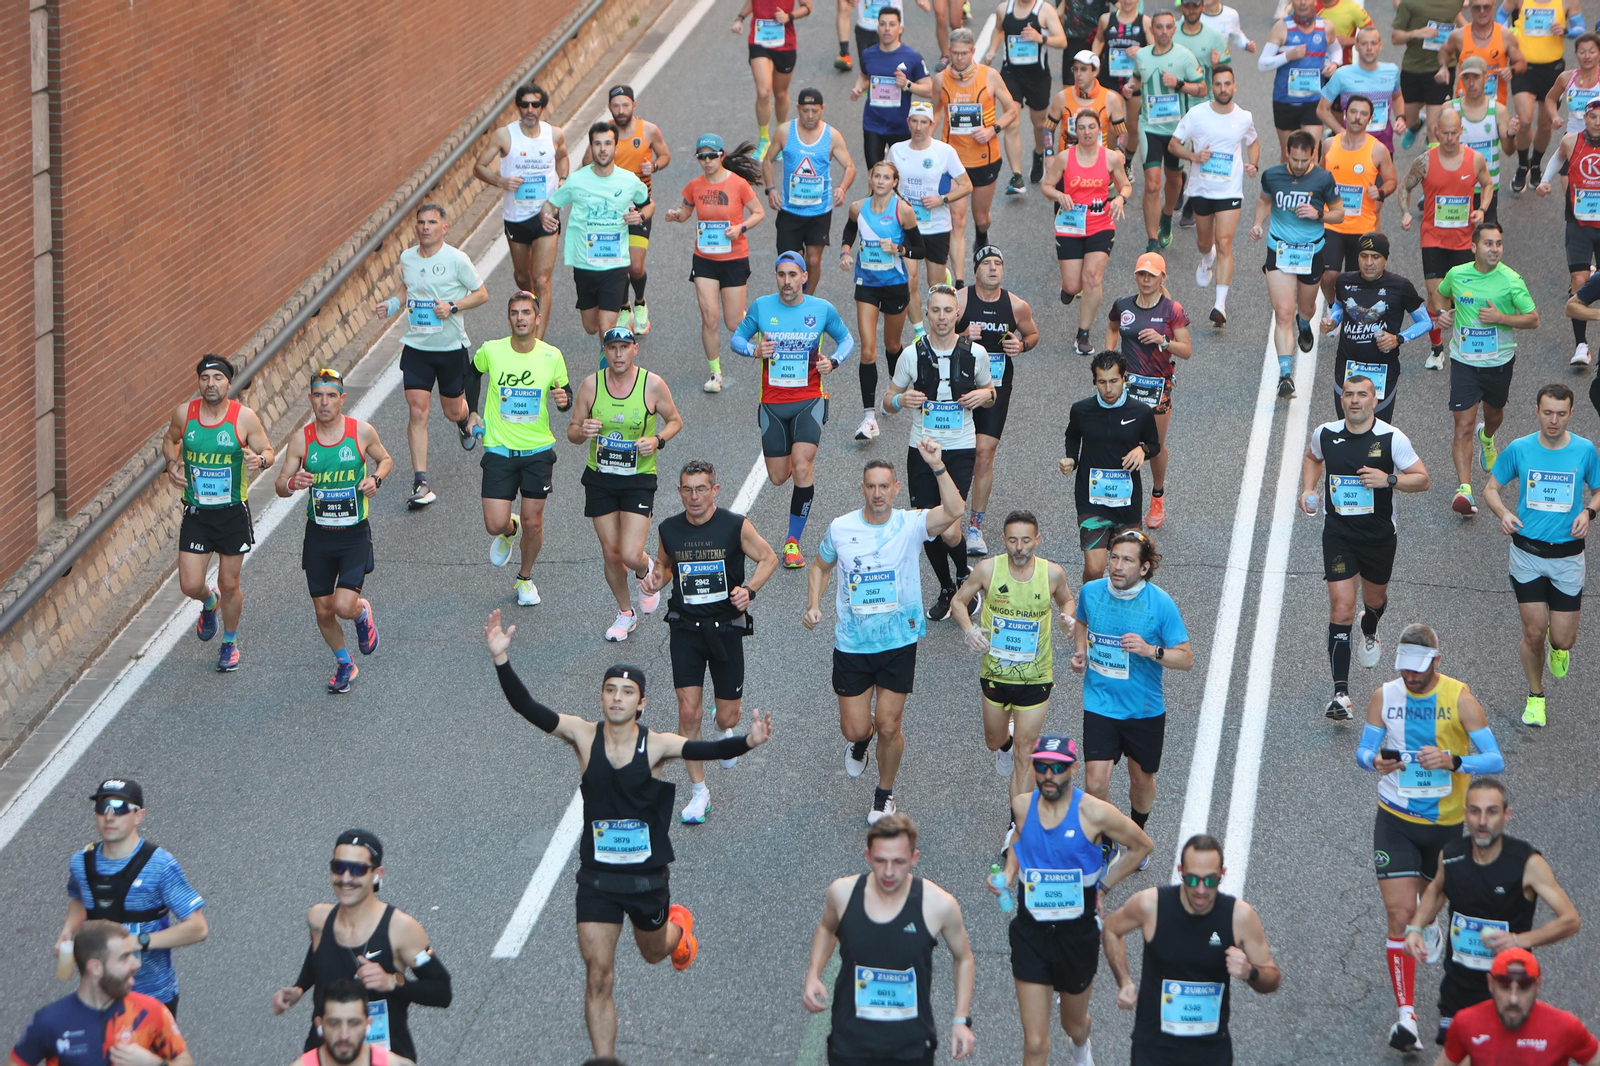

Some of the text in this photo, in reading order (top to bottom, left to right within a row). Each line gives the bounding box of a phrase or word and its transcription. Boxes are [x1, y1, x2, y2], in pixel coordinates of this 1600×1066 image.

[1080, 178, 1103, 187] asics
[936, 402, 959, 410] ZURICH
[610, 441, 633, 449] ZURICH
[187, 450, 233, 465] BIKILA
[313, 469, 356, 484] BIKILA
[1543, 474, 1568, 482] ZURICH
[864, 573, 890, 581] ZURICH
[694, 578, 710, 586] 2942
[865, 588, 881, 596] 3567
[1007, 622, 1033, 630] ZURICH
[1387, 706, 1451, 721] CANARIAS
[612, 821, 641, 829] ZURICH
[613, 836, 630, 844] 3879
[1044, 874, 1074, 882] ZURICH
[877, 973, 909, 981] ZURICH
[1184, 986, 1215, 994] ZURICH
